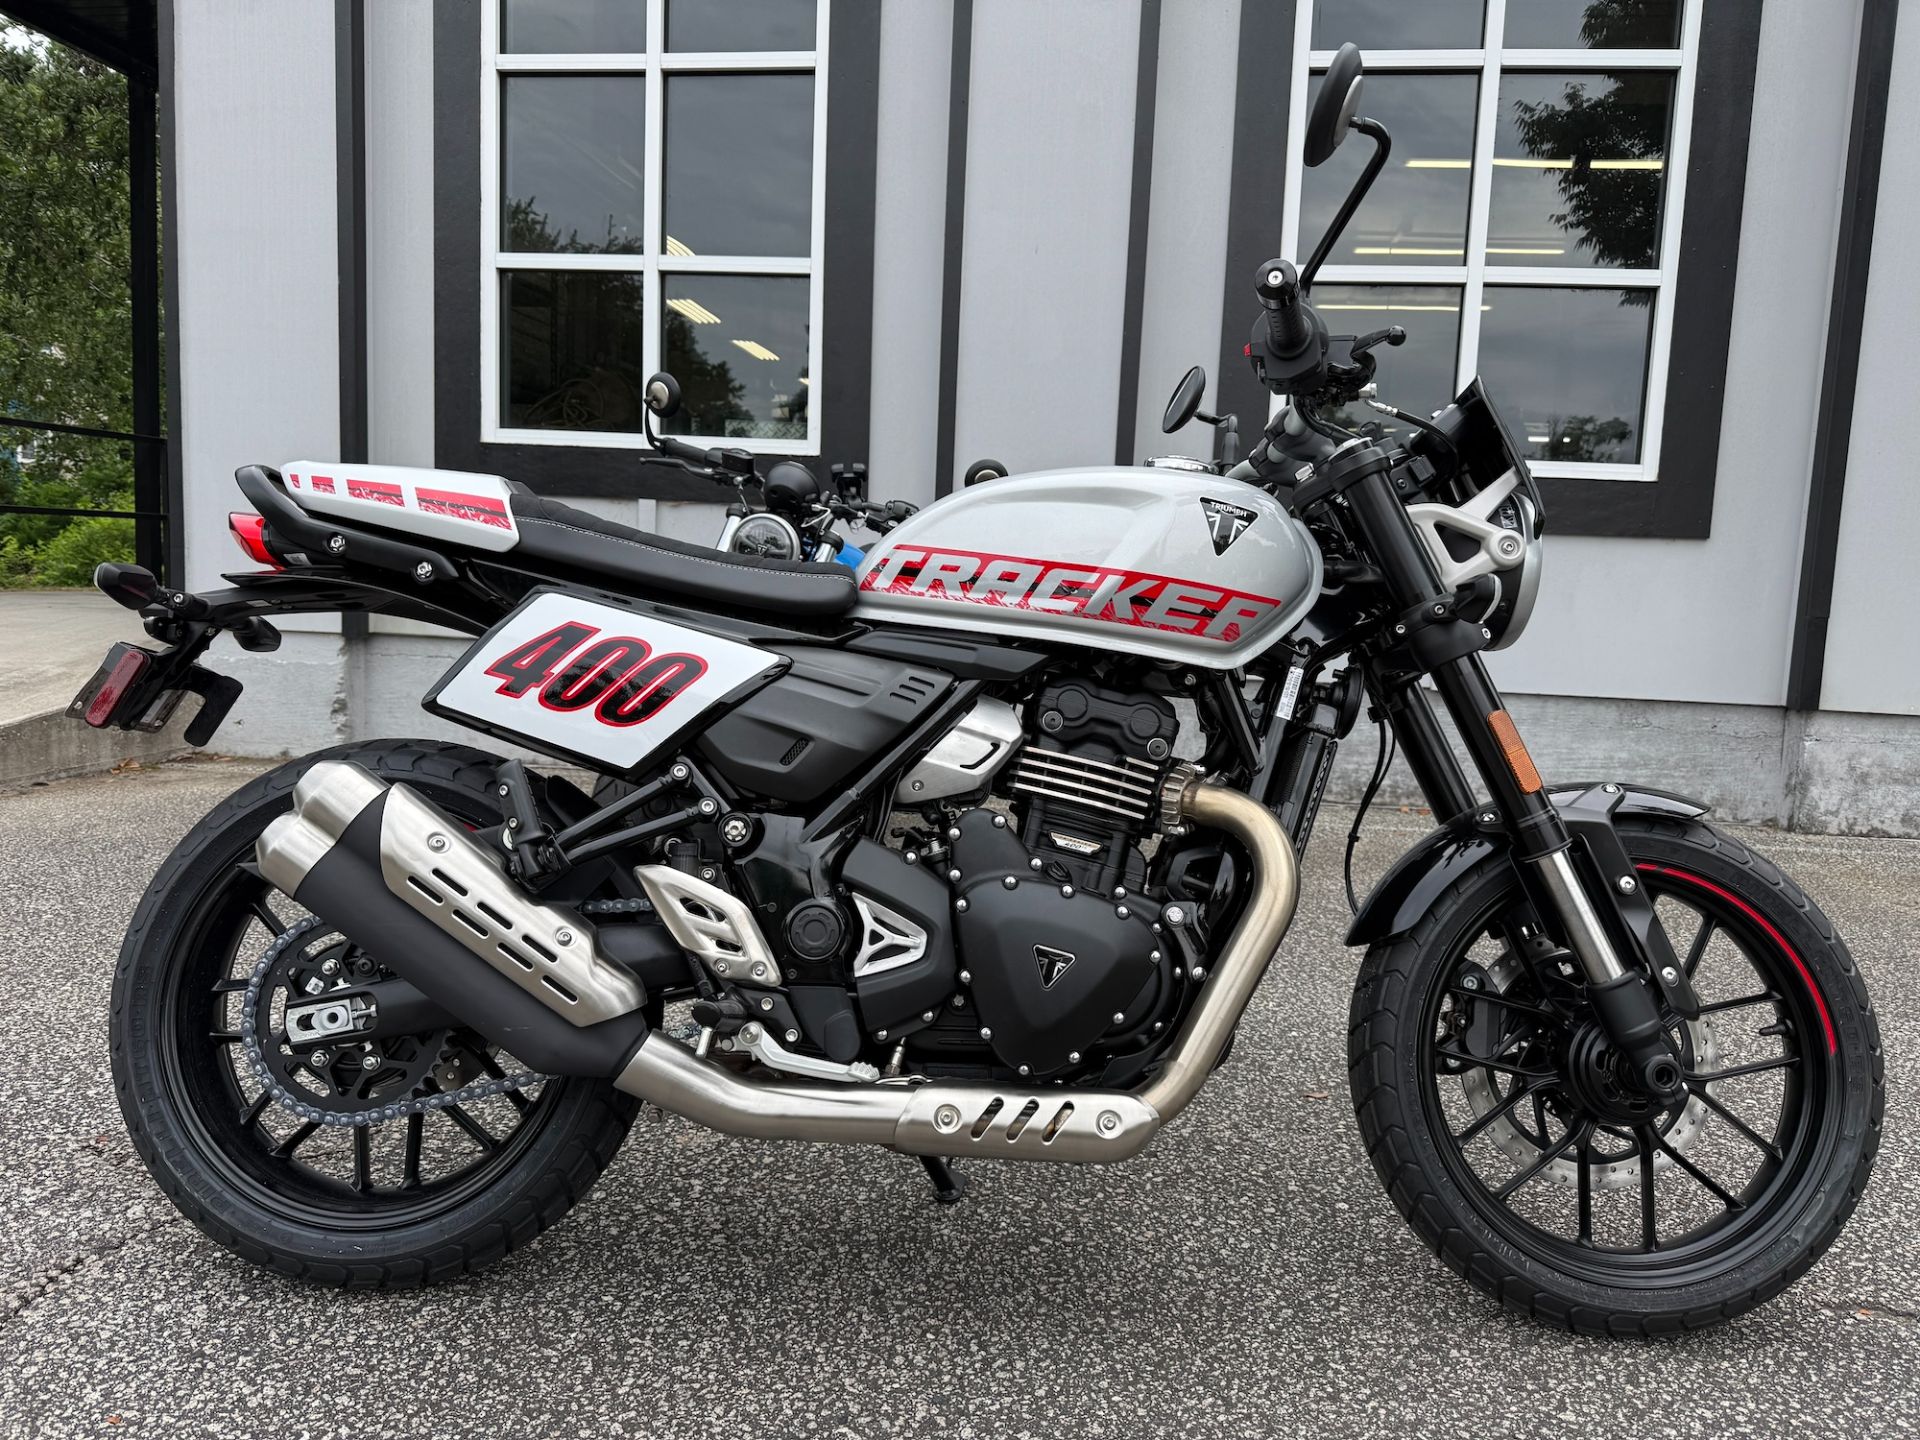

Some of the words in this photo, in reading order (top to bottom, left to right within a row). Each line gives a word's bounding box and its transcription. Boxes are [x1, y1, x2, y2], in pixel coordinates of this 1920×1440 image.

[1210, 501, 1247, 518] TRIUMPH
[873, 549, 1277, 640] TRACKER
[483, 620, 709, 727] 400
